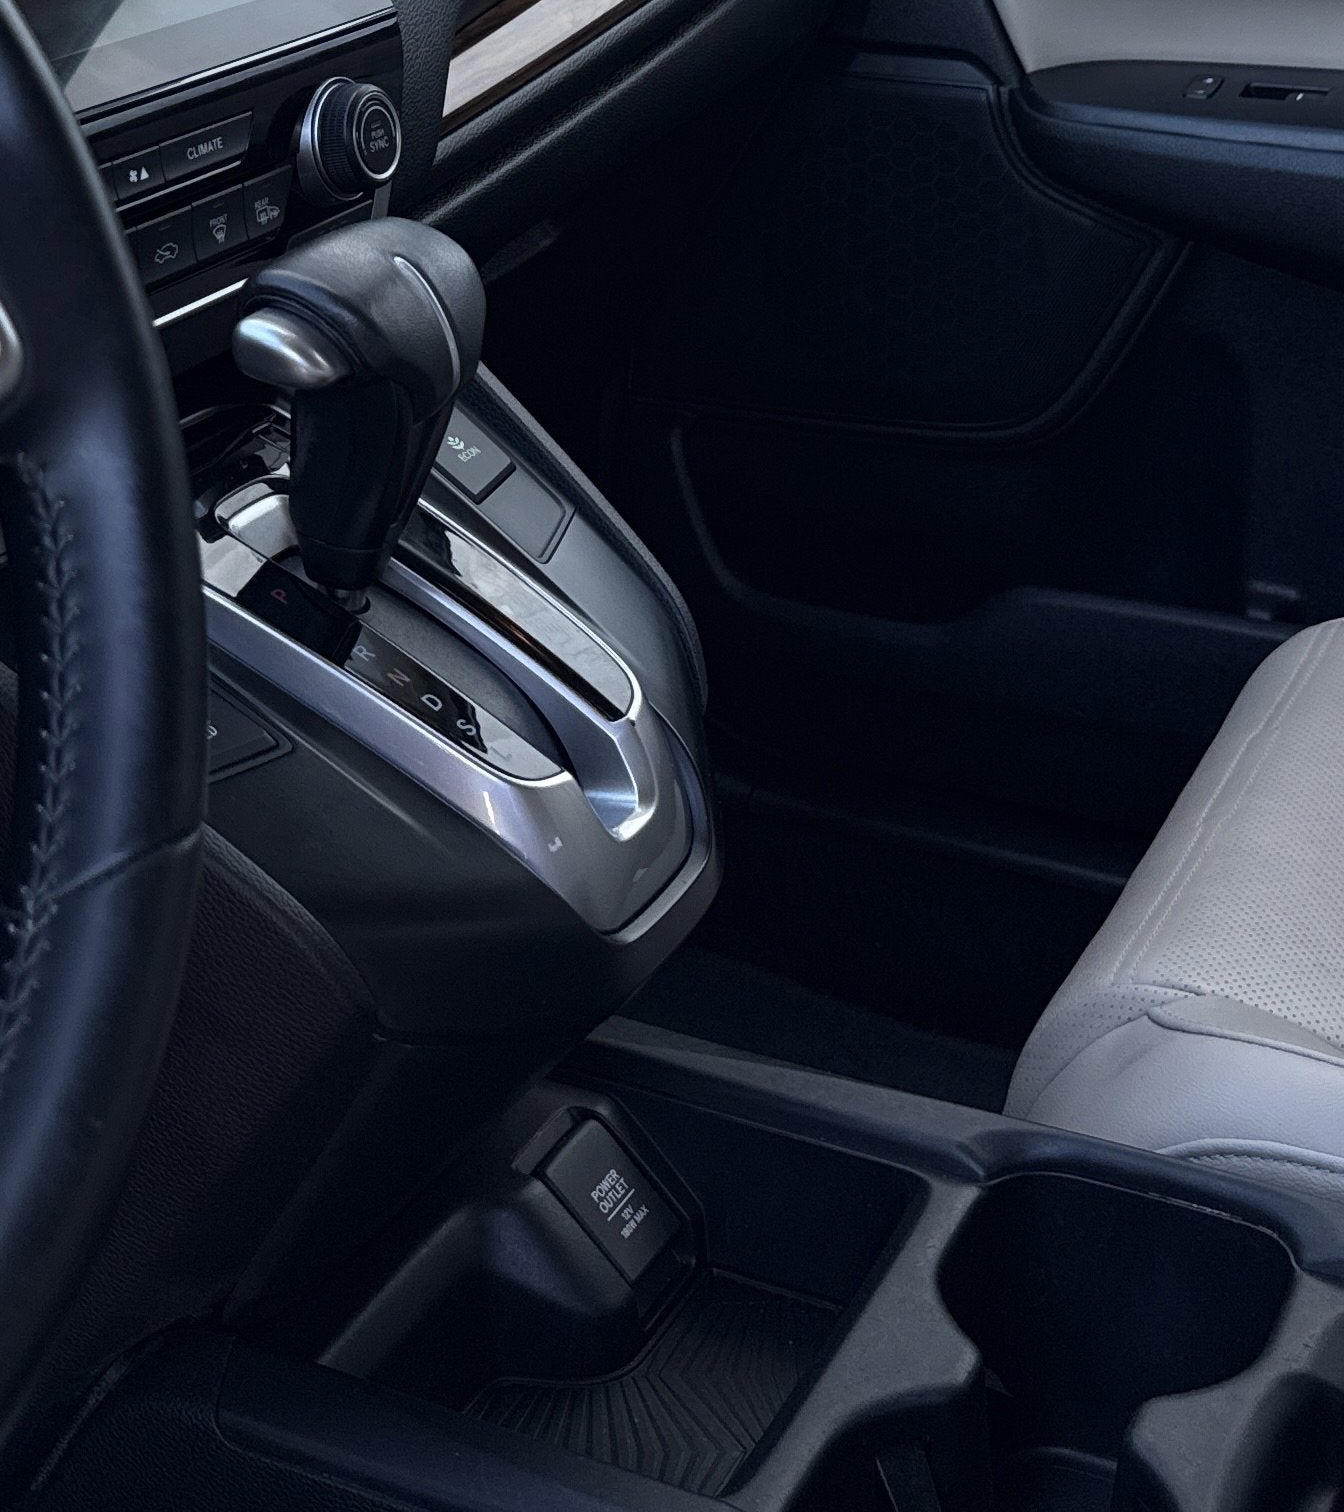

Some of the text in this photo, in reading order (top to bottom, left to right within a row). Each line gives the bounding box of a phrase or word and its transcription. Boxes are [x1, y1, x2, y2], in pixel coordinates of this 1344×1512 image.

[186, 135, 225, 161] CLIMATE
[369, 135, 390, 153] SYNC
[457, 445, 482, 463] ECON
[270, 588, 288, 604] P
[351, 644, 376, 662] R
[386, 667, 412, 687] N
[420, 693, 444, 712] D
[456, 718, 478, 737] S
[590, 1168, 621, 1203] POWER
[599, 1176, 629, 1214] OUTLET
[621, 1204, 635, 1220] 12V
[634, 1204, 650, 1222] MAX
